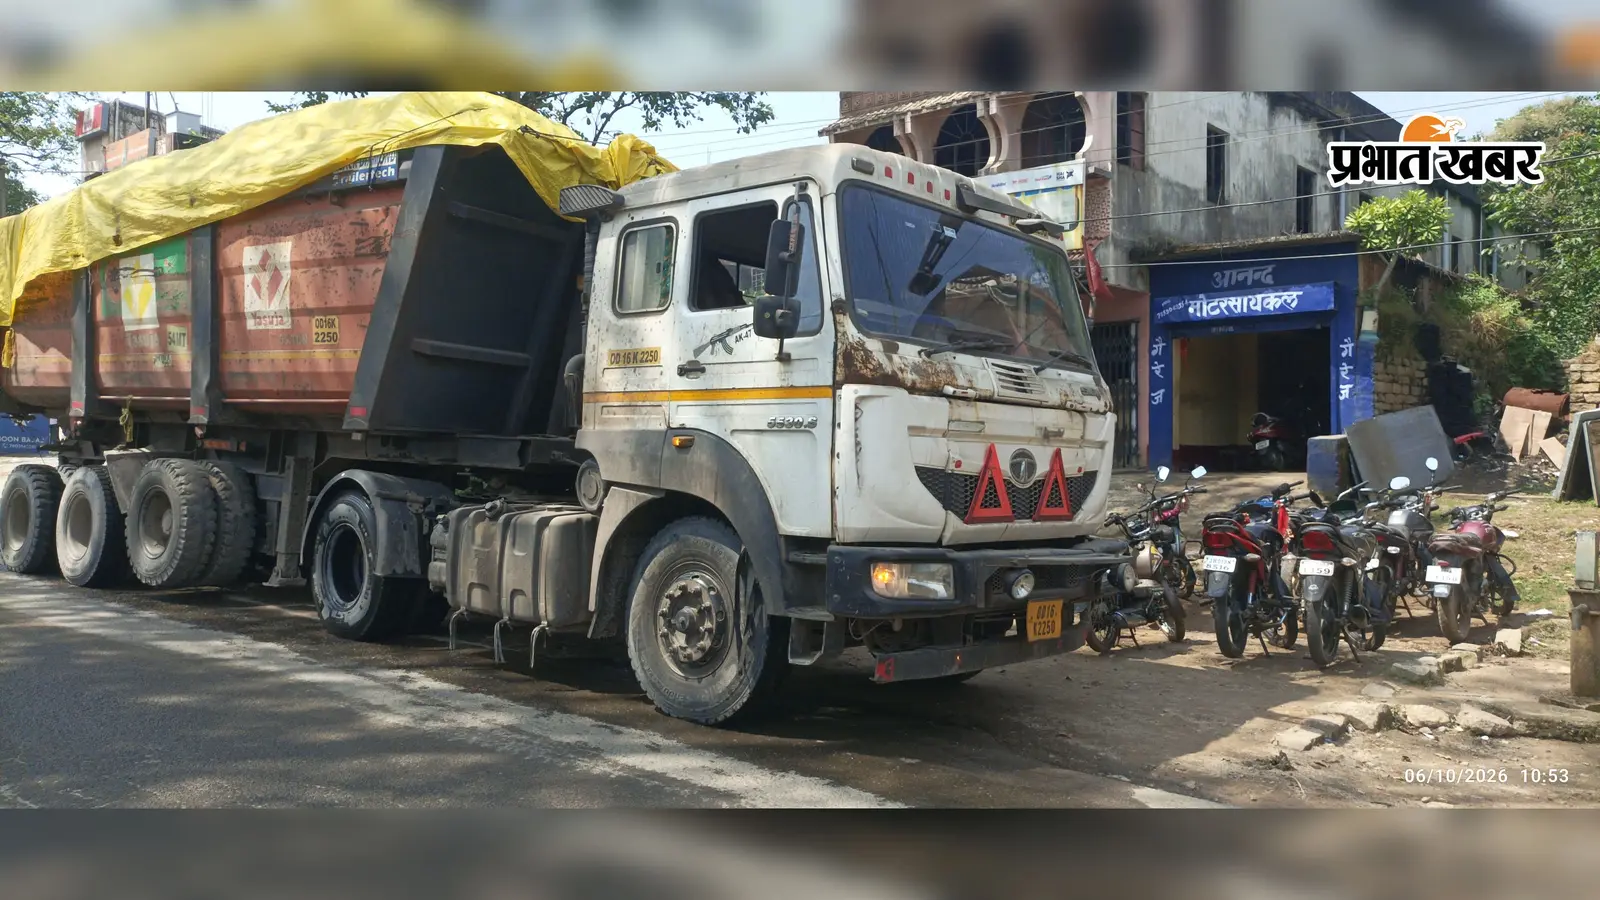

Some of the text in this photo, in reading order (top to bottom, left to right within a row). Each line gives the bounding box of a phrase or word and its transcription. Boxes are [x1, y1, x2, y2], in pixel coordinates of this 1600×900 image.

[1212, 264, 1276, 288] आनन्द
[1188, 291, 1303, 318] मोटरसायकल
[251, 311, 284, 327] Yasuja
[314, 331, 338, 343] 2250
[734, 328, 752, 344] AK-47
[622, 351, 631, 365] 16
[632, 351, 638, 364] K
[640, 350, 658, 363] 2250
[1034, 620, 1056, 636] K2250
